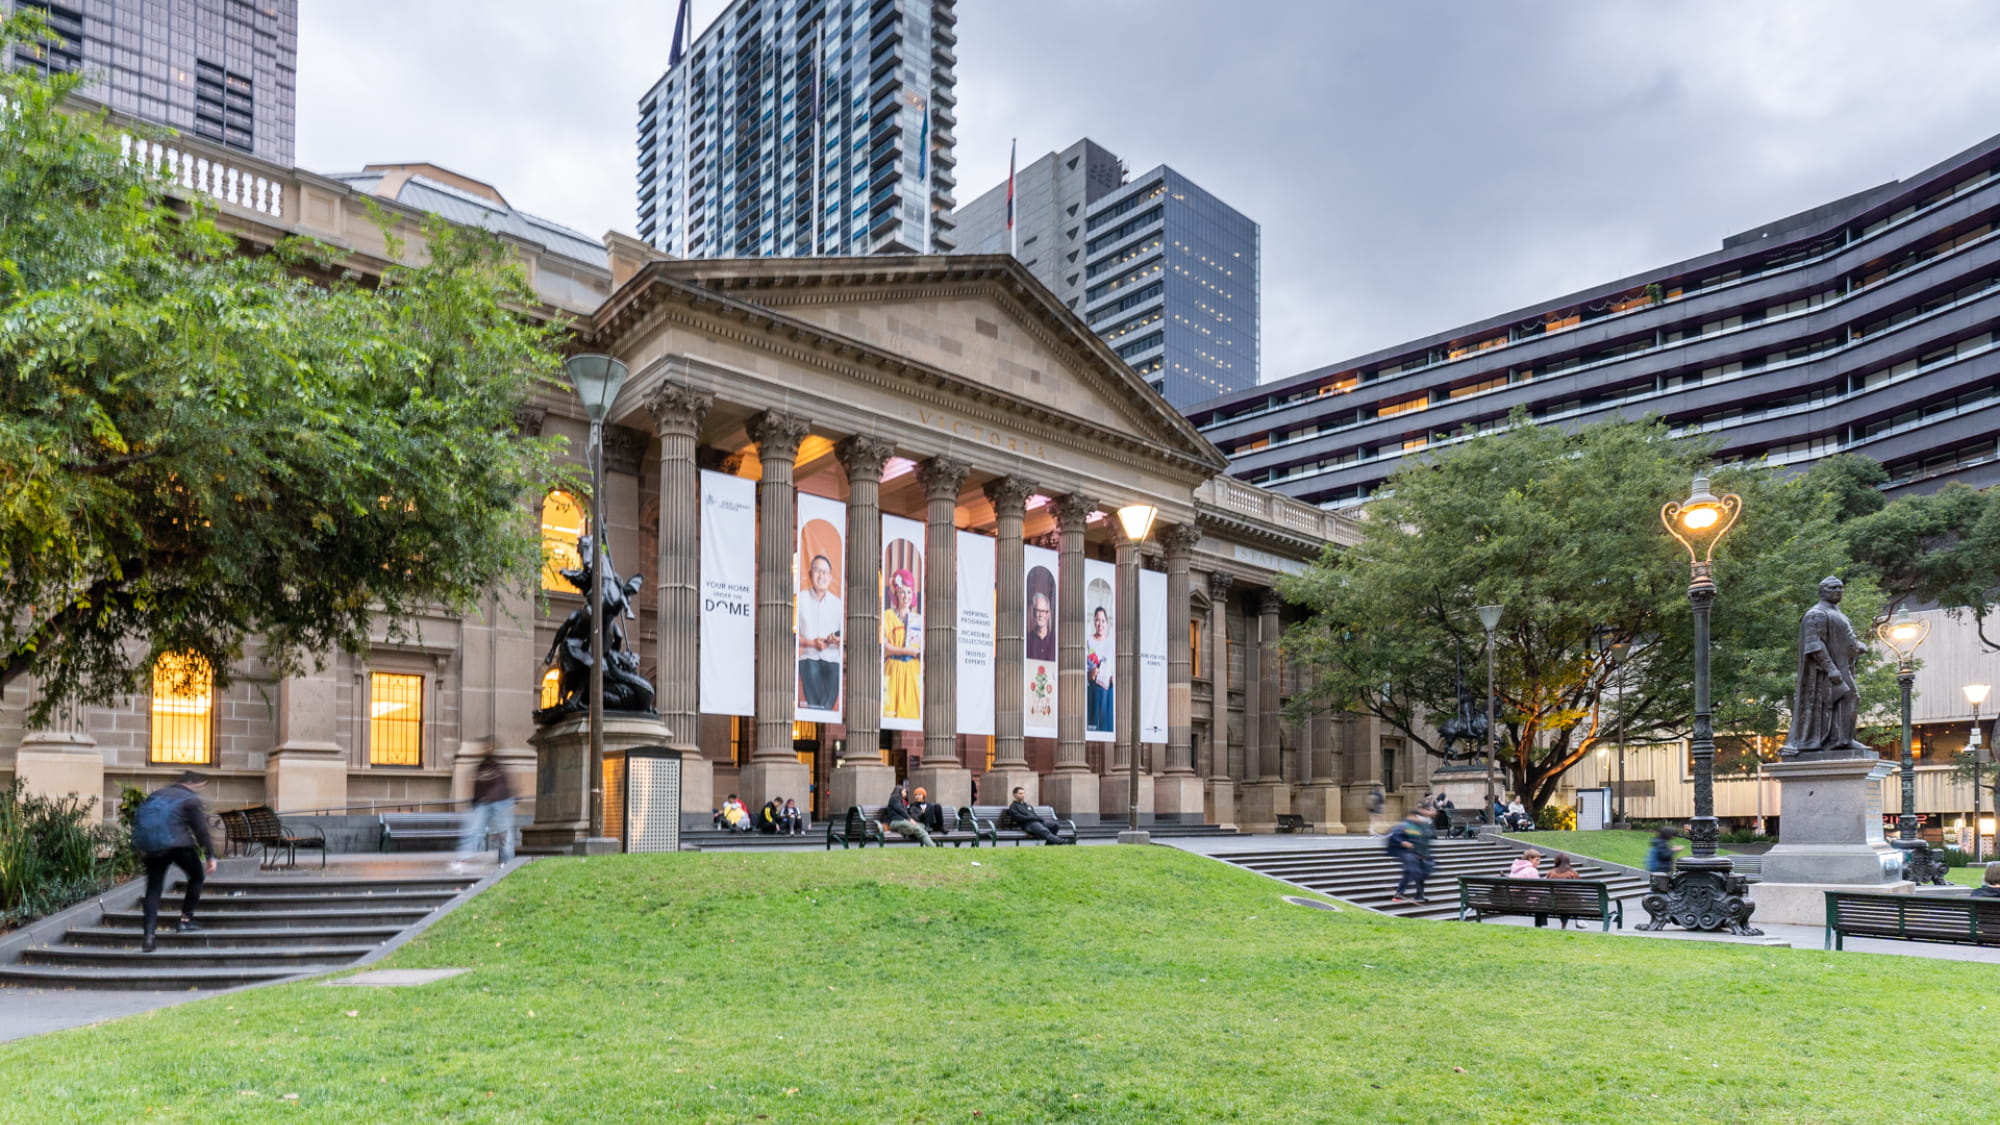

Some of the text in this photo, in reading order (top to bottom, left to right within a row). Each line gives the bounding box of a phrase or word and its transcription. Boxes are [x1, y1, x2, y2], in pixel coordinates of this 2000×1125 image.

[919, 409, 1046, 460] VICTORIA
[705, 580, 749, 593] YOUR HOME
[963, 609, 989, 618] INSPIRING
[961, 630, 990, 639] INCREDIBLE
[958, 636, 993, 647] COLLECTIONS
